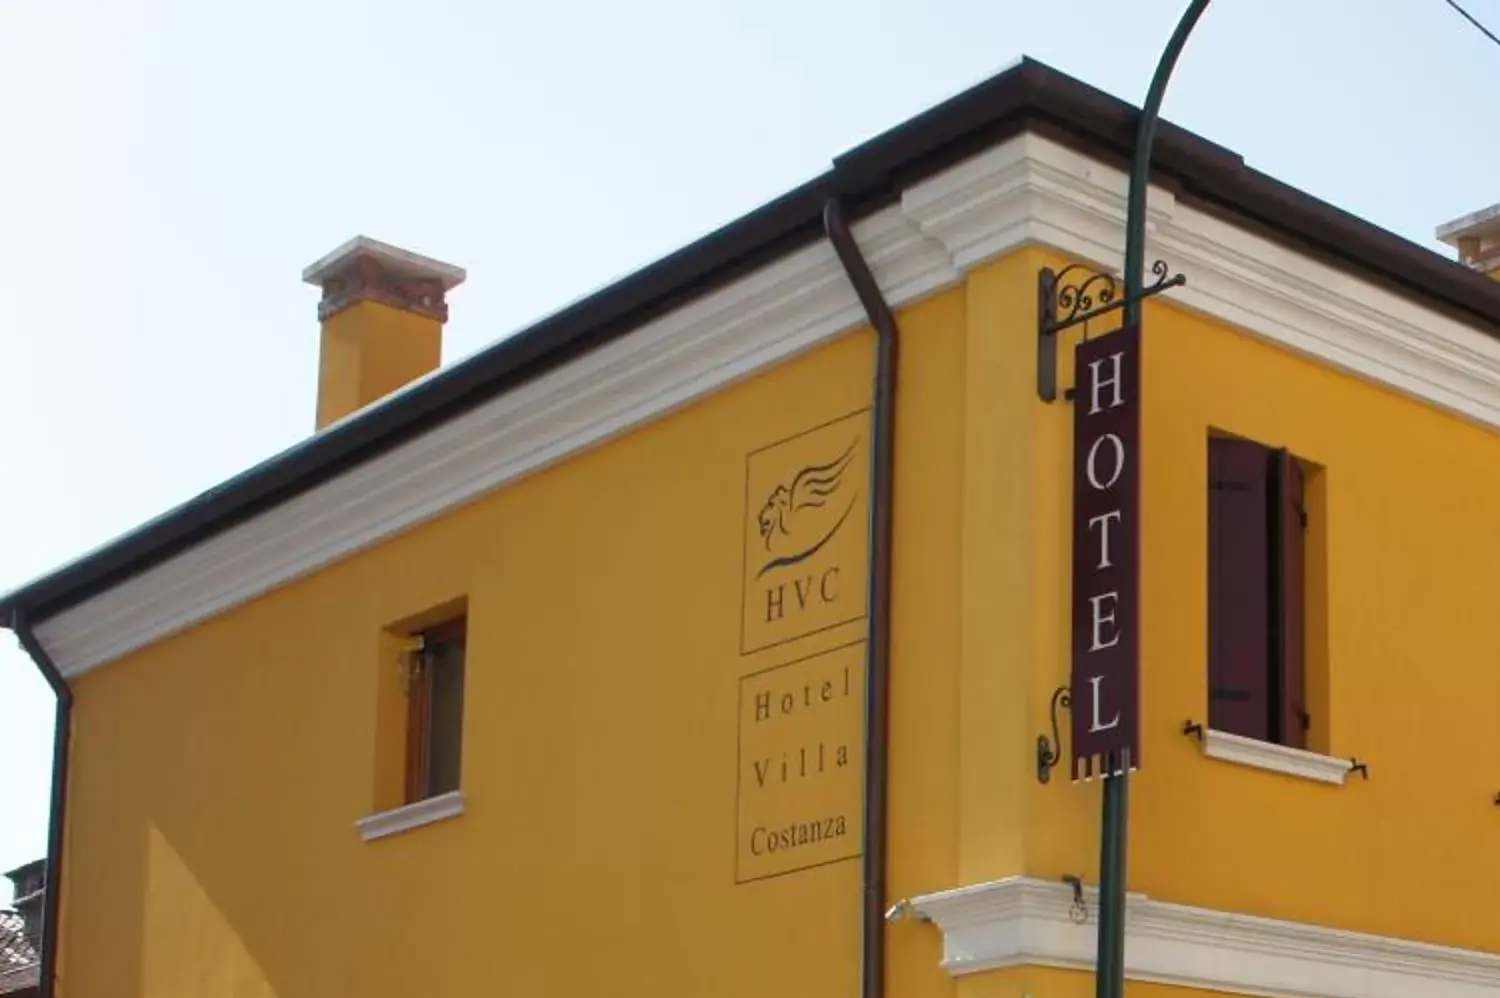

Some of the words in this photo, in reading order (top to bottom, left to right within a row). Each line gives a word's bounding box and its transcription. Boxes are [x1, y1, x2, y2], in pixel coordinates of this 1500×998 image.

[1086, 351, 1126, 734] HOTEL
[764, 567, 840, 623] HVC
[754, 667, 850, 723] Hotel
[753, 742, 849, 789] Villa
[750, 812, 847, 857] Costanza
